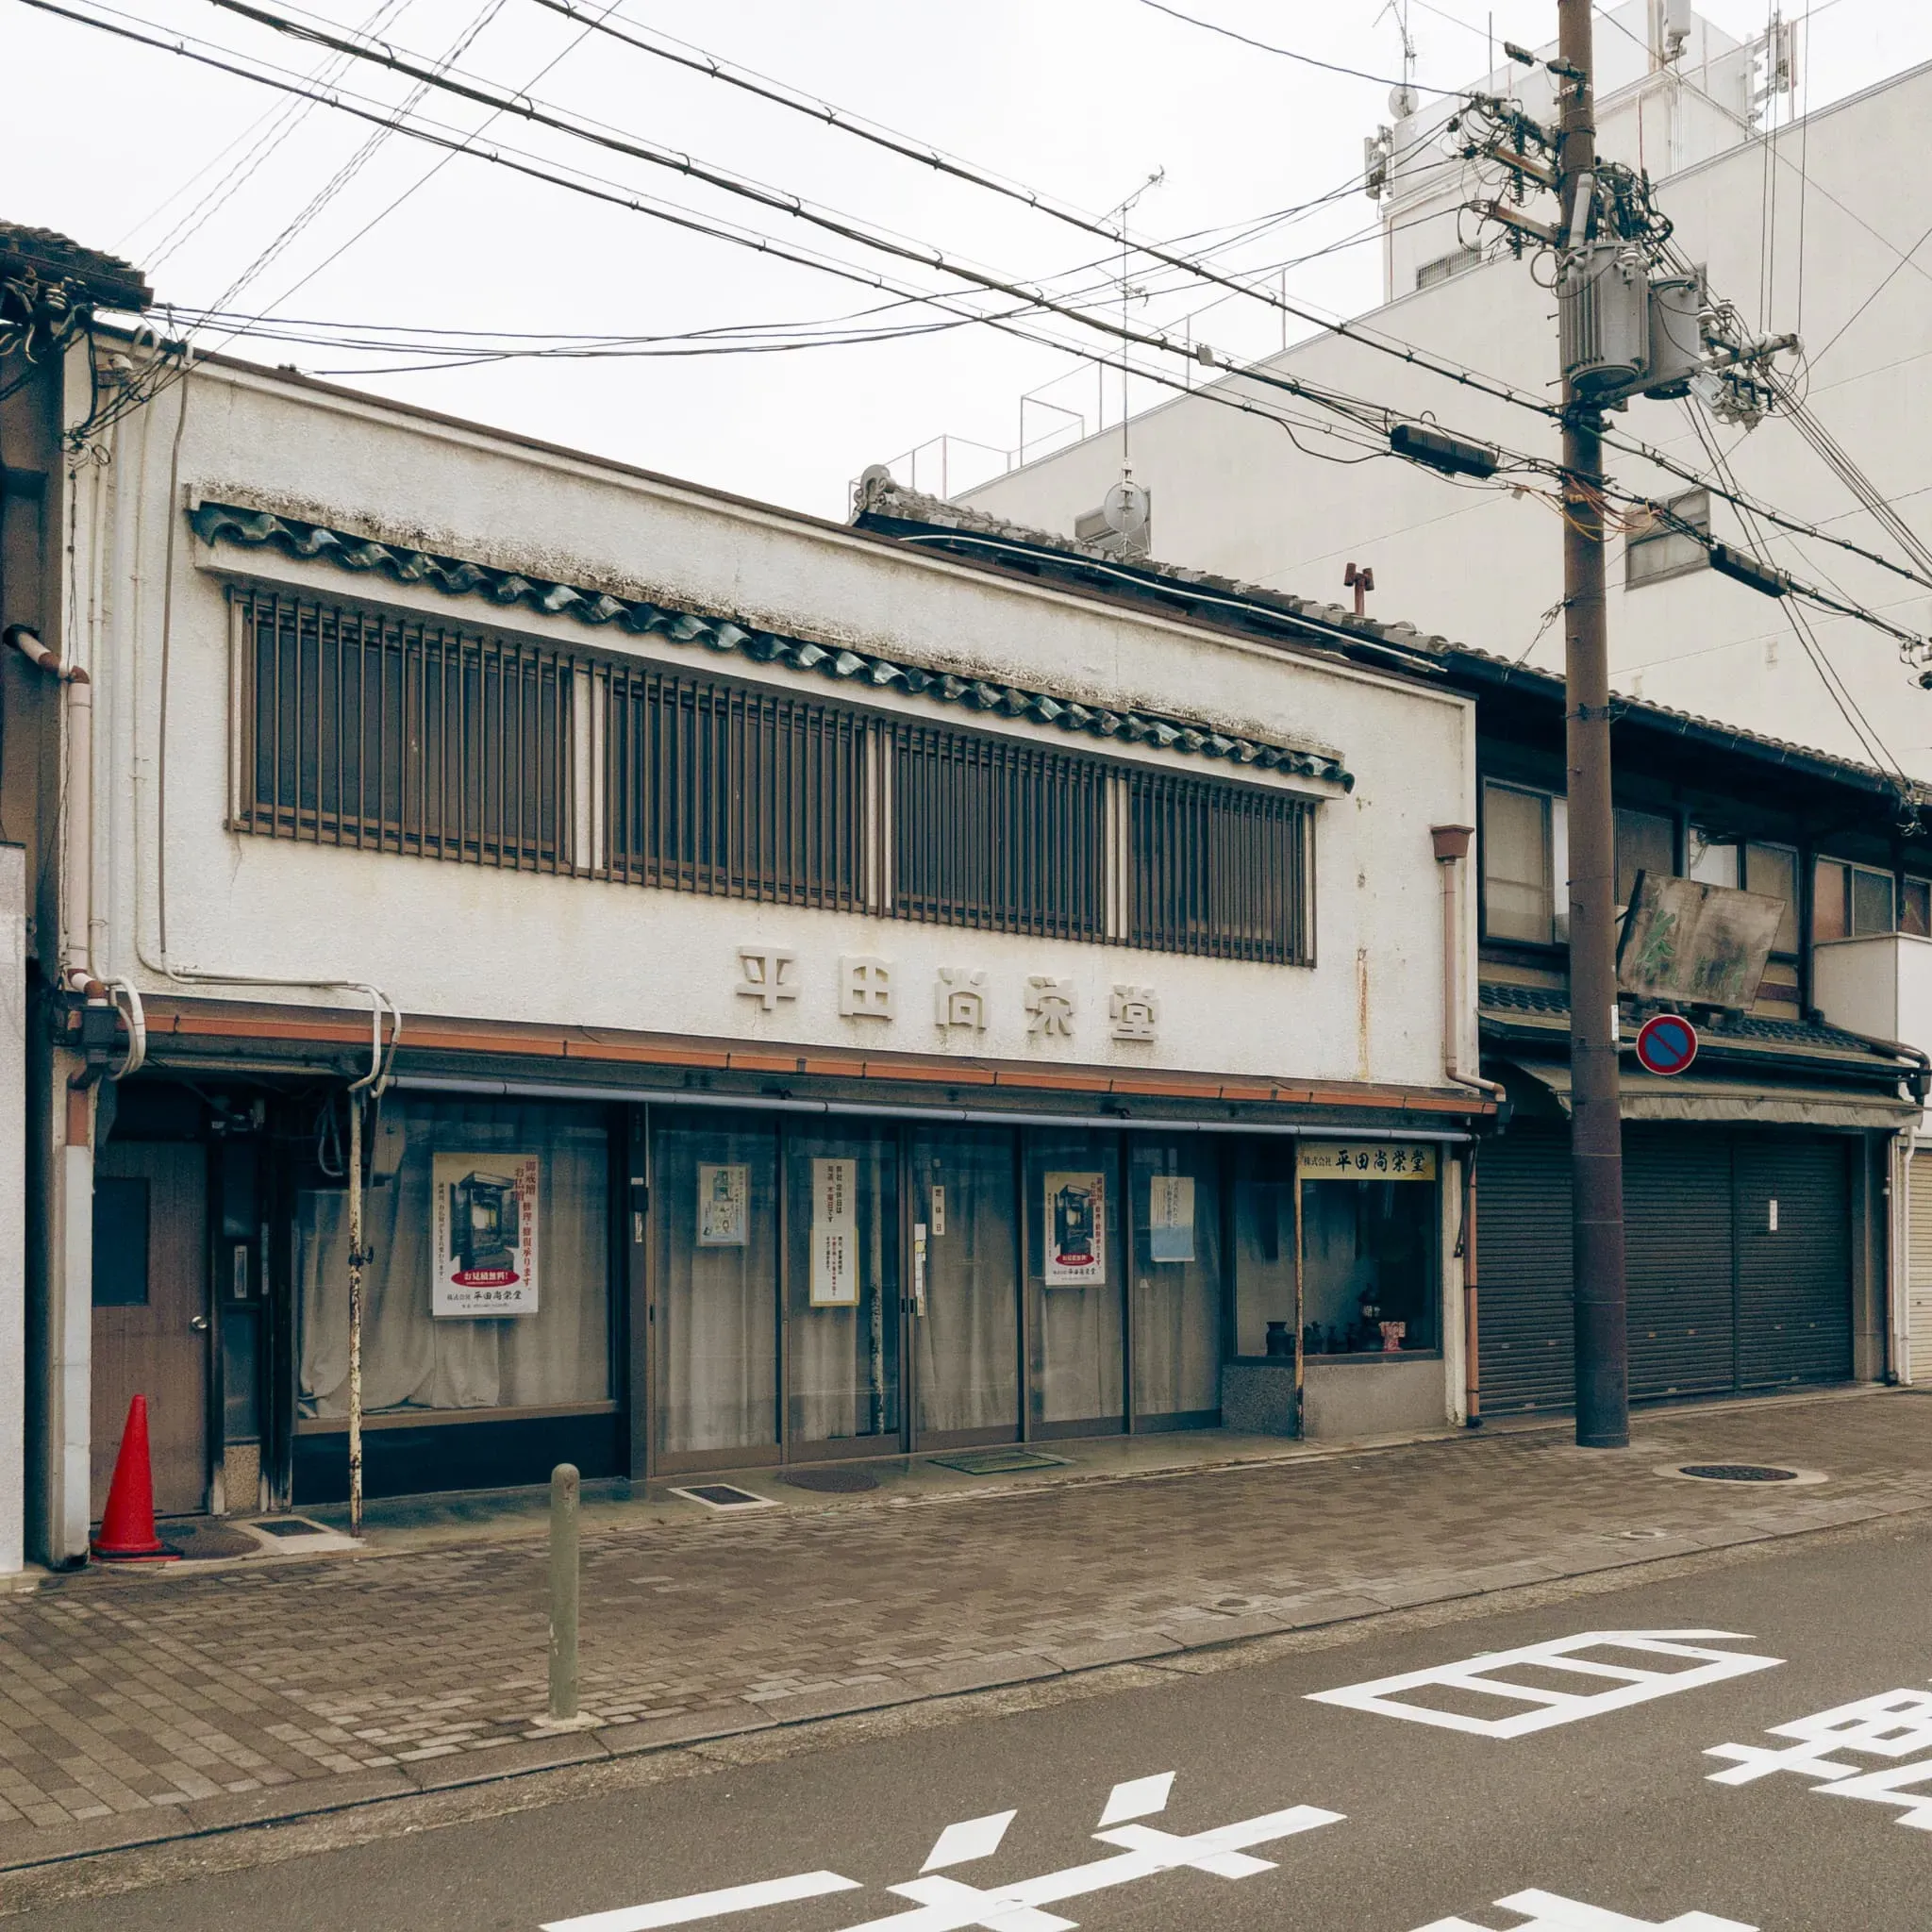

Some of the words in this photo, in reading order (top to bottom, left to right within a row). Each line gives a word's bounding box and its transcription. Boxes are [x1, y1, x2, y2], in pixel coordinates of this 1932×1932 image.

[735, 945, 1159, 1041] 平田尚栄堂
[1304, 1156, 1331, 1168] 株式会社
[1336, 1149, 1425, 1173] 平田尚栄堂
